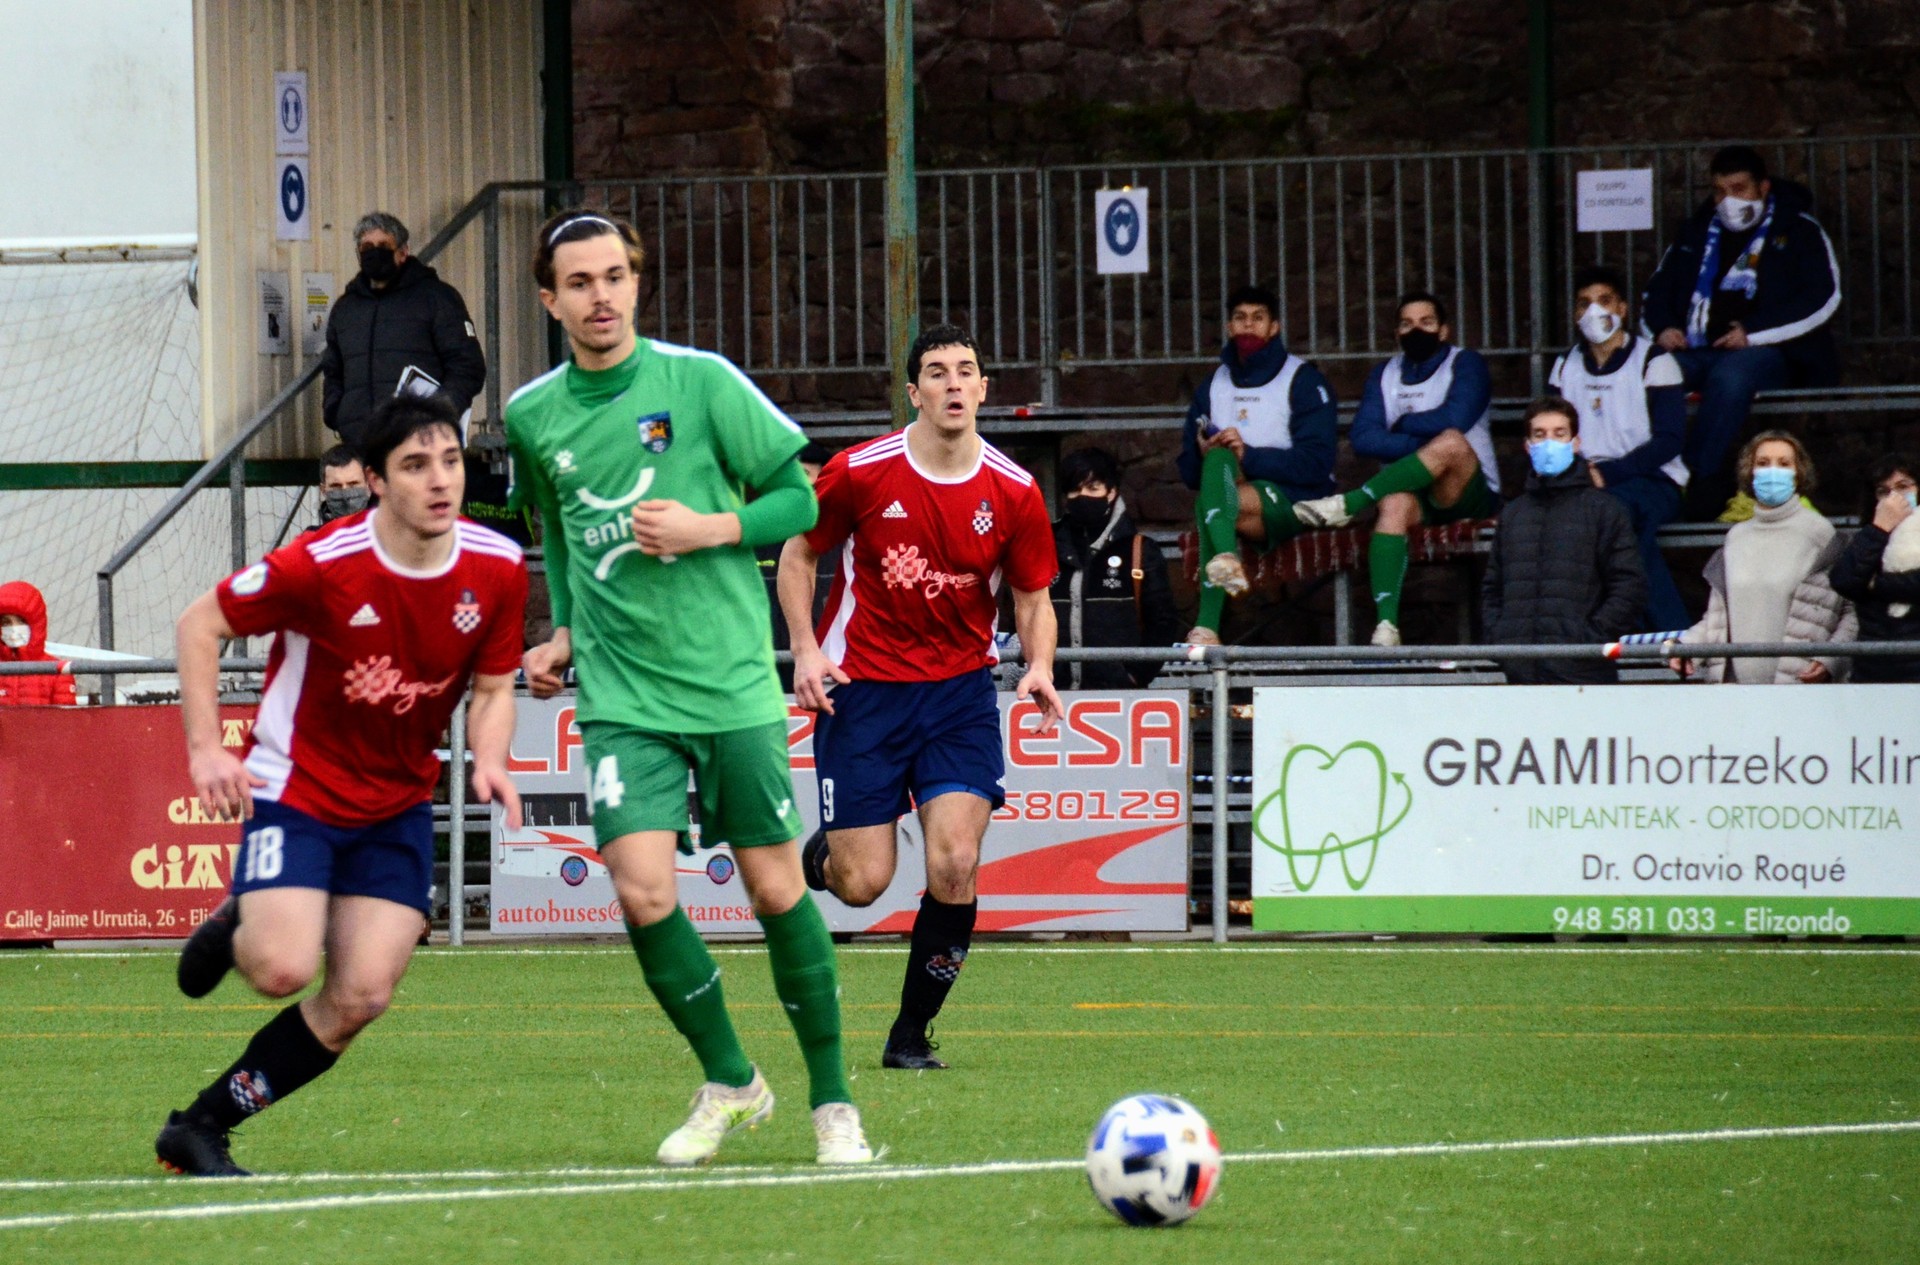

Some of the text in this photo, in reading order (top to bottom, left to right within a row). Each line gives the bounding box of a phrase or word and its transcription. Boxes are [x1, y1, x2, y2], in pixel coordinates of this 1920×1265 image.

[584, 511, 634, 547] enh
[1528, 805, 1680, 830] INPLANTEAK
[1707, 805, 1902, 830] ORTODONTZIA
[246, 826, 283, 881] 18
[1582, 853, 1846, 889] Dr. Octavio Roqué
[5, 910, 43, 928] Calle
[45, 910, 89, 931] Jaime
[93, 909, 151, 928] Urrutia,
[156, 909, 176, 926] 26
[1553, 907, 1601, 932] 948
[1611, 907, 1656, 932] 581
[1667, 907, 1716, 932] 033
[1744, 906, 1850, 934] Elizondo
